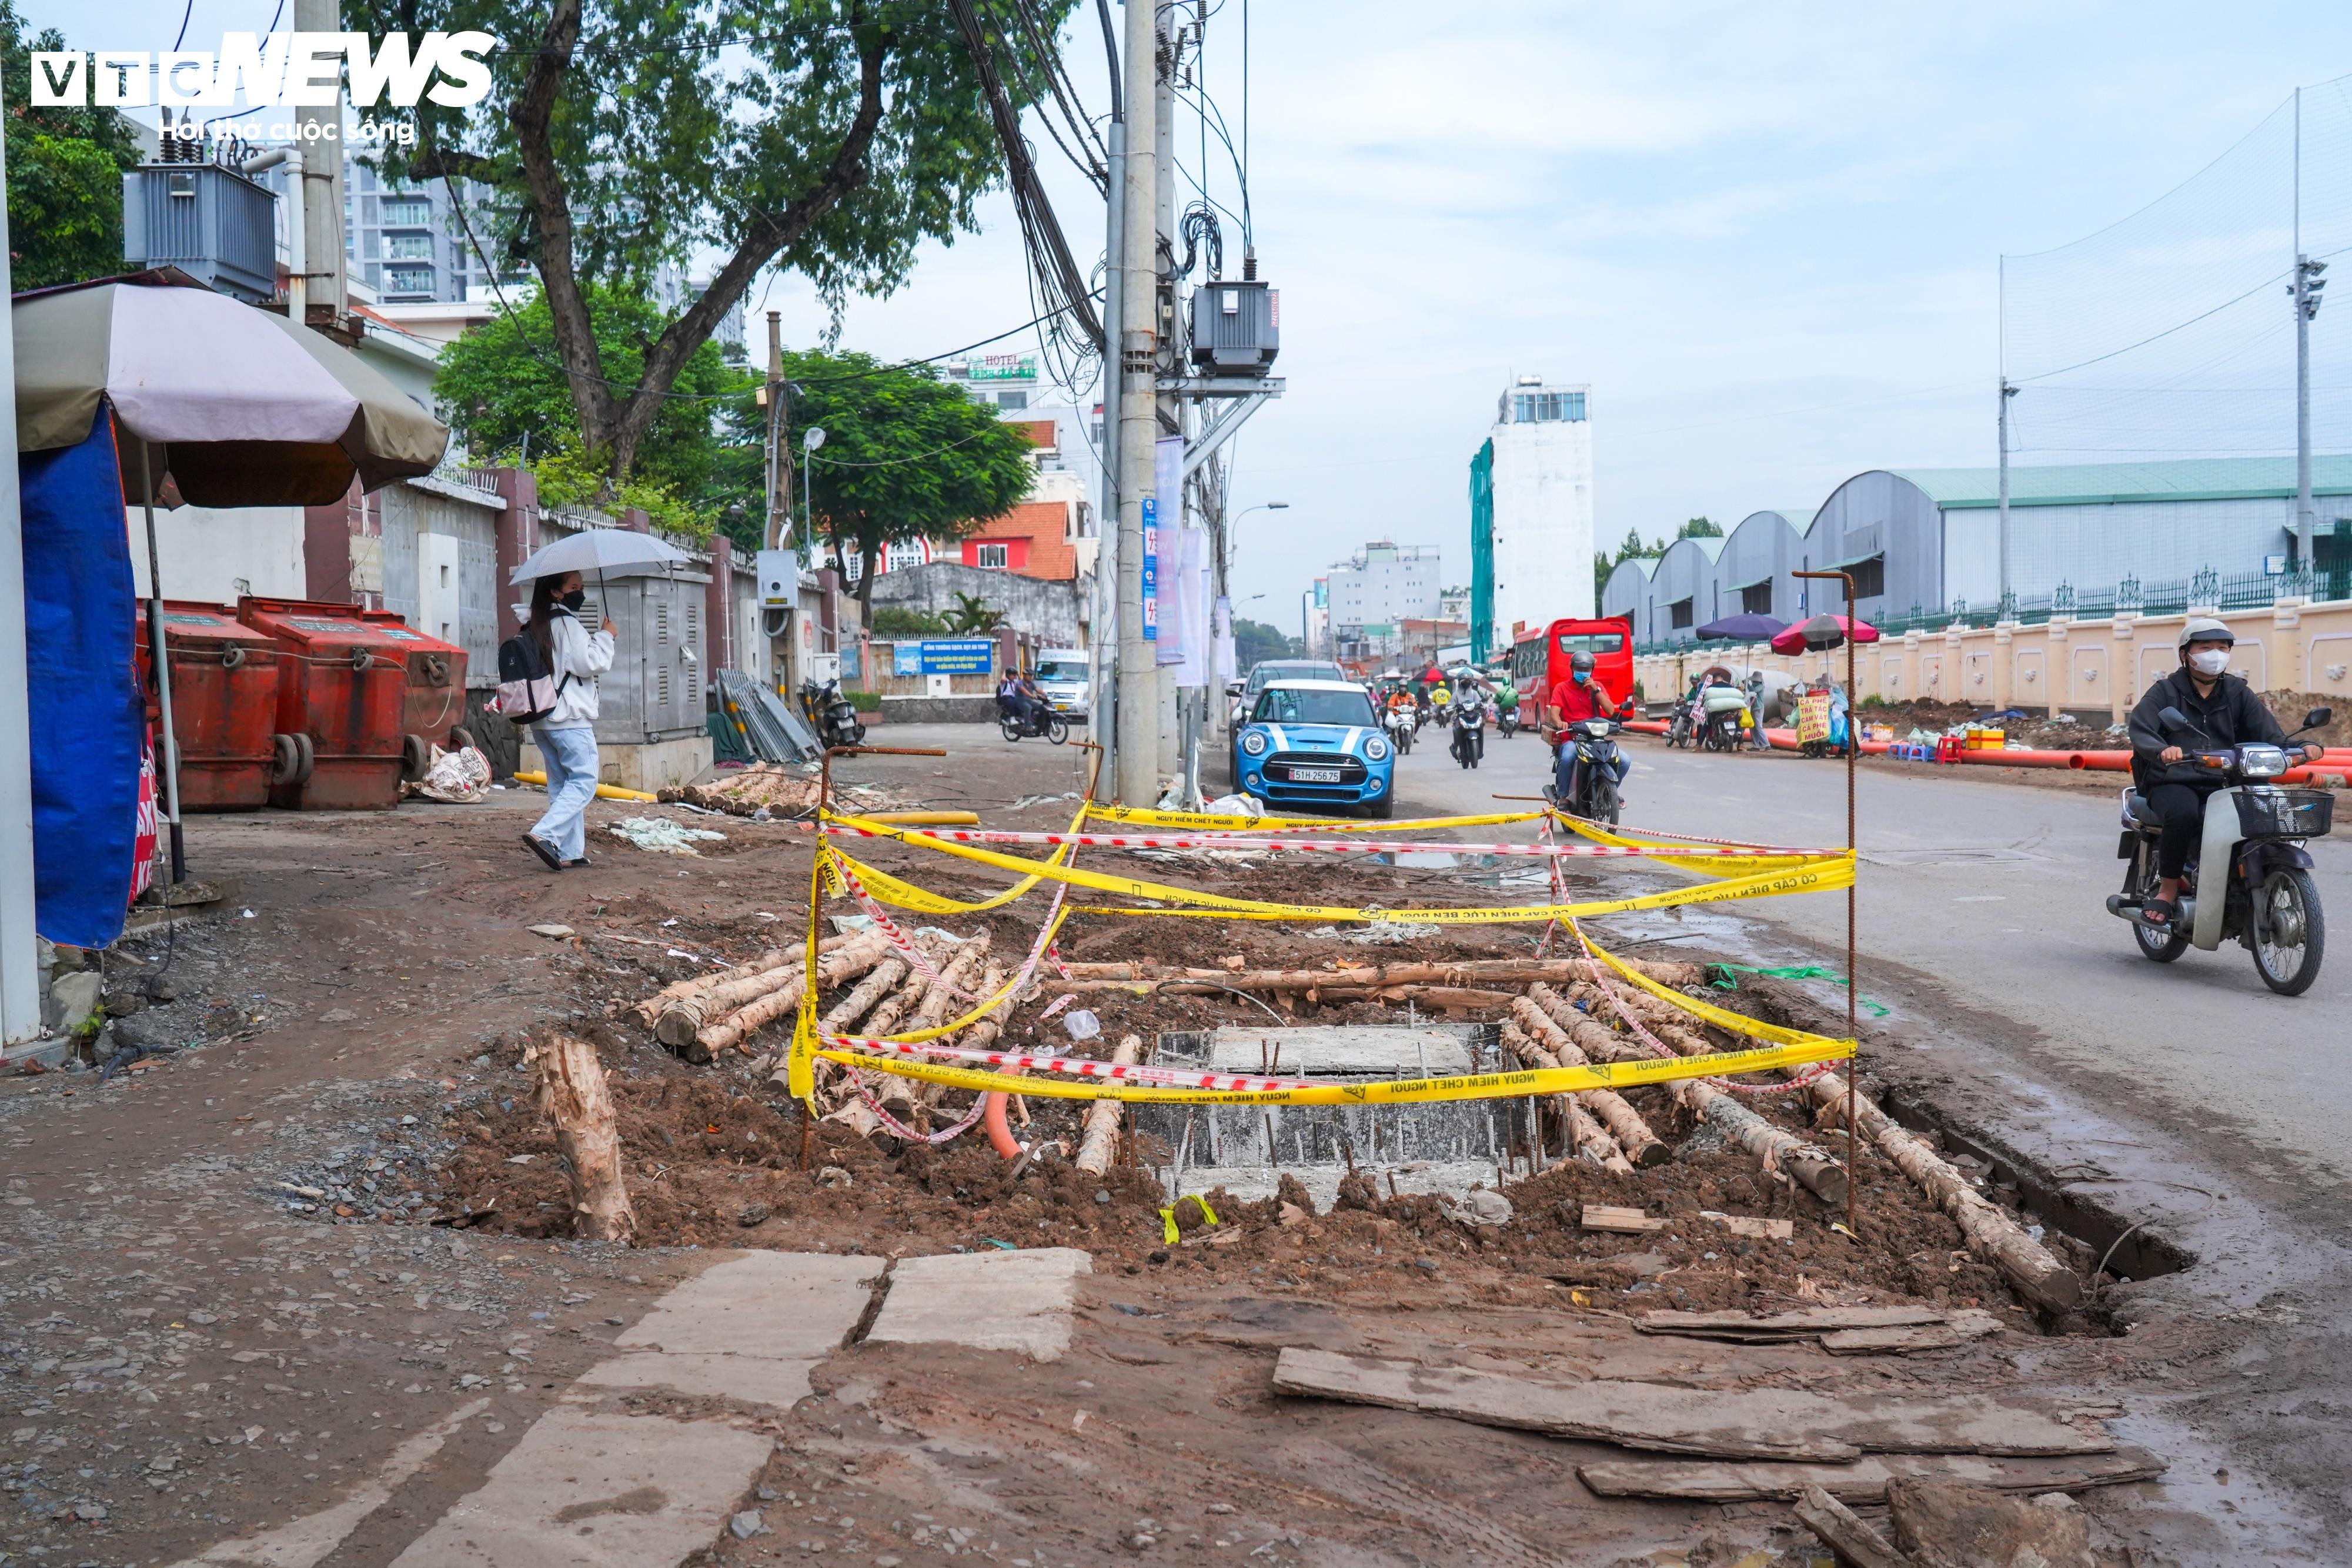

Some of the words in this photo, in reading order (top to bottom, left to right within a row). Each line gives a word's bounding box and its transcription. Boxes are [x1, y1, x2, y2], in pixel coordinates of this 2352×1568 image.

[986, 356, 1020, 365] HOTEL
[1296, 771, 1338, 781] 51H-256.75
[1175, 814, 1192, 823] HIỂM
